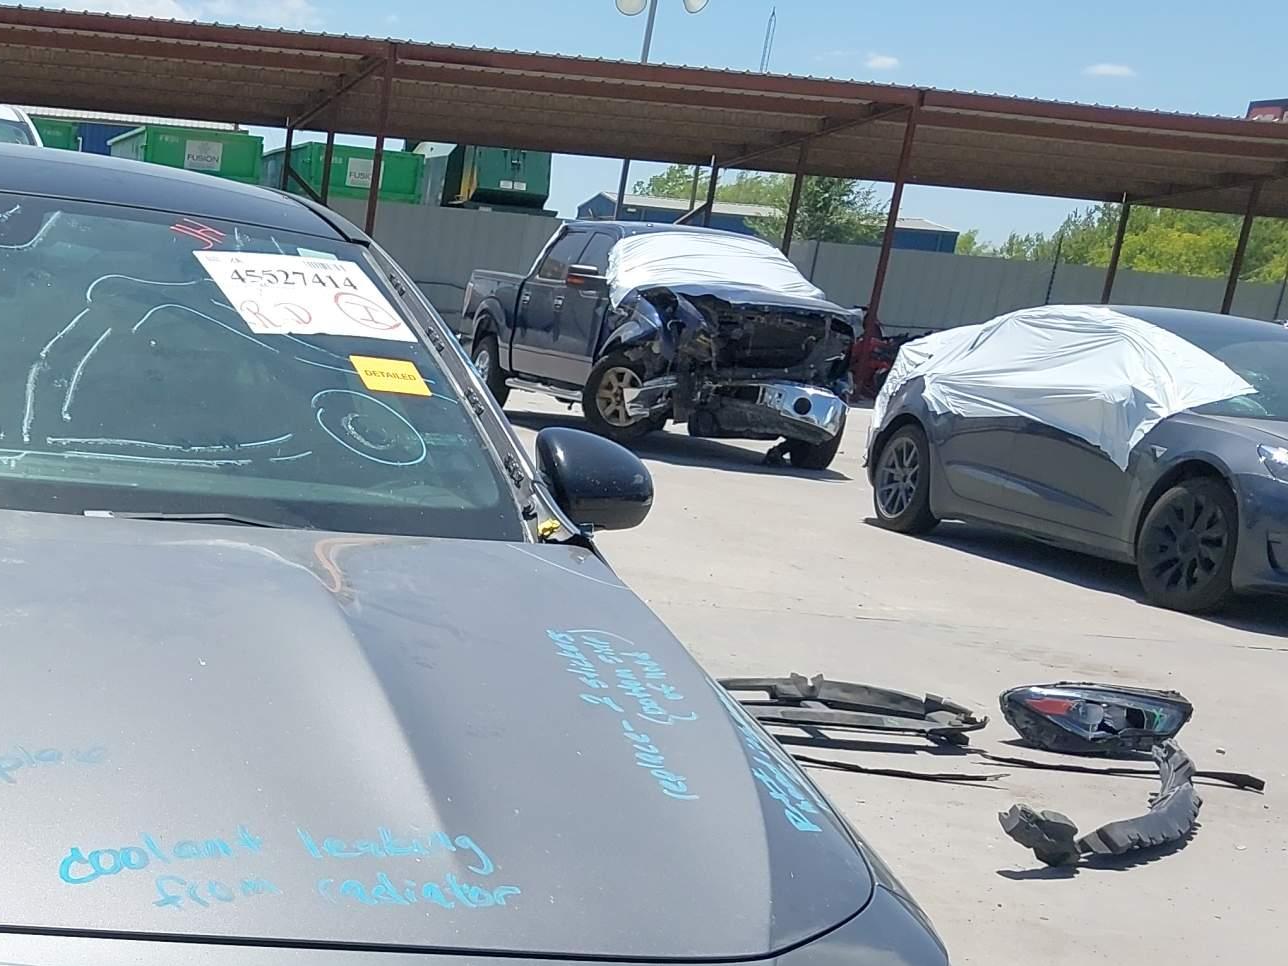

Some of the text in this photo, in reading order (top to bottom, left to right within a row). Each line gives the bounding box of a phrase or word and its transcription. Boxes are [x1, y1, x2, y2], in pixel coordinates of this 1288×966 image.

[187, 153, 219, 164] FUSION
[230, 268, 359, 291] 45527414
[364, 369, 417, 382] DETAILED
[58, 824, 265, 885] coolant
[152, 872, 521, 912] from radiator
